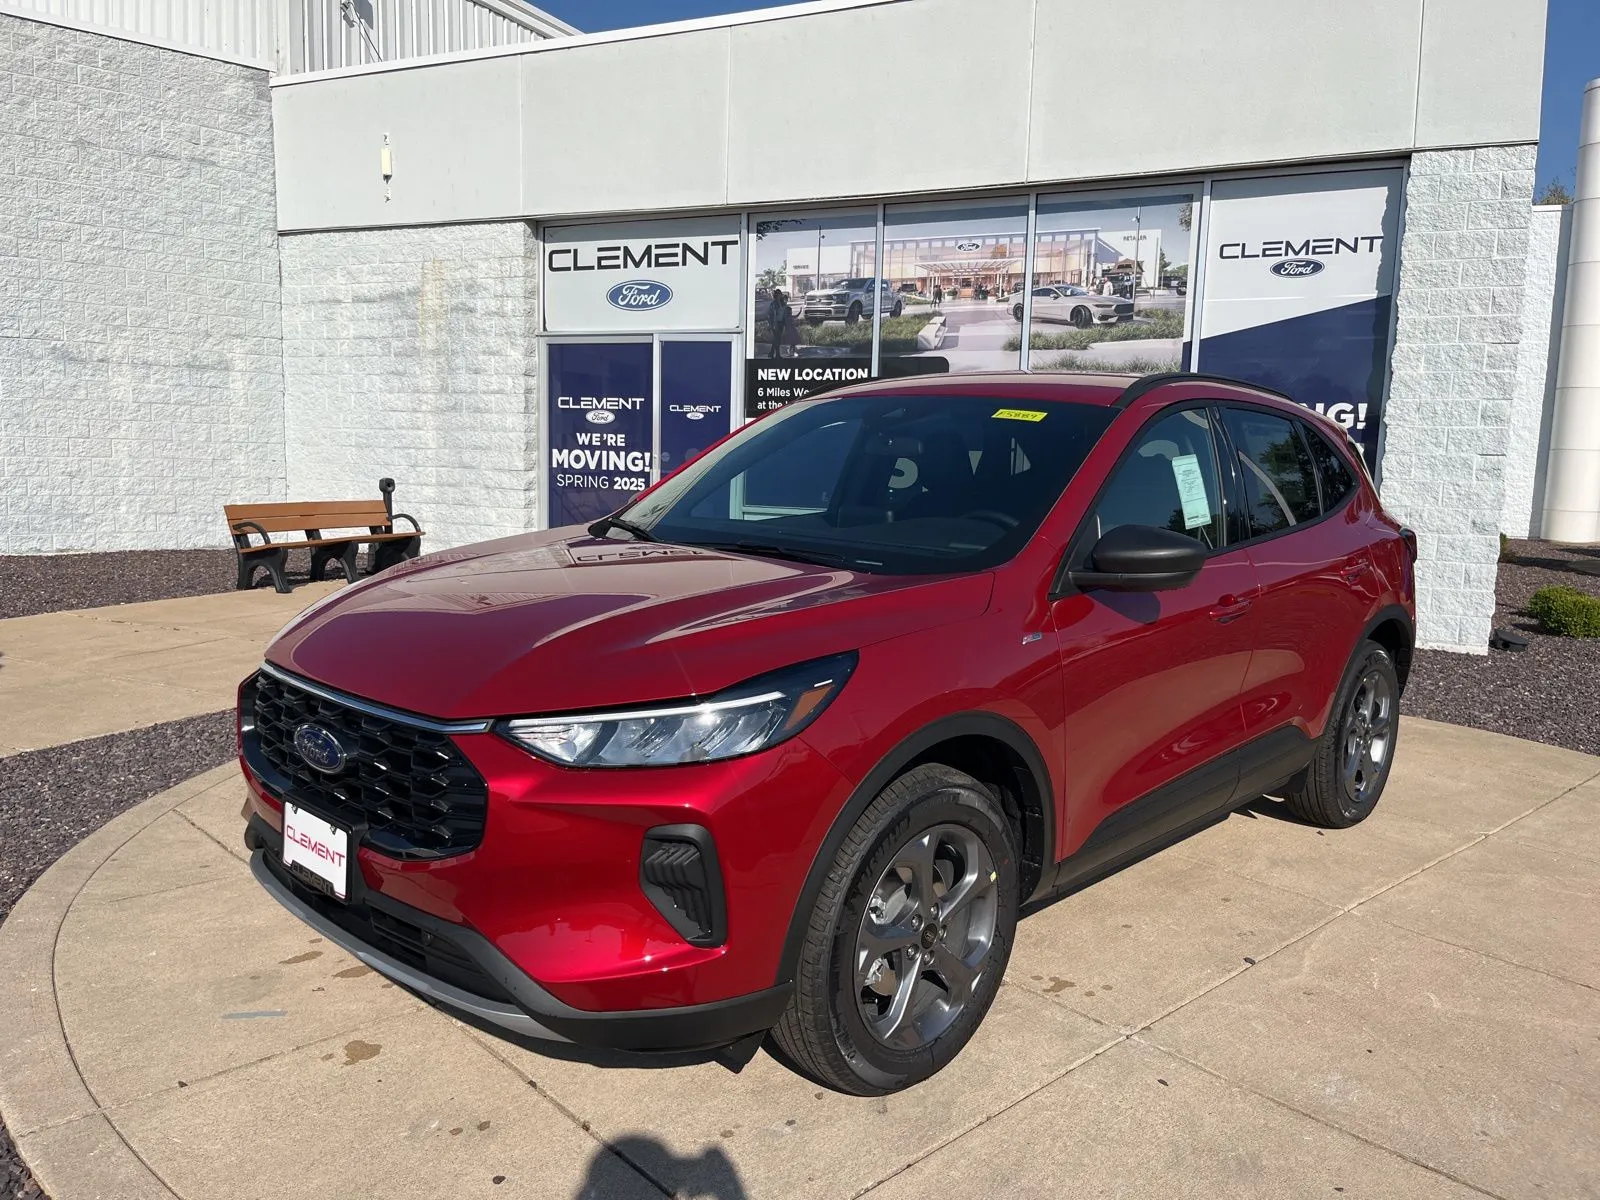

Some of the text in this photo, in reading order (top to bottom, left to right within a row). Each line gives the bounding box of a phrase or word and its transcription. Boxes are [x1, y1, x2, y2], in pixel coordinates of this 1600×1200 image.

[1219, 236, 1385, 260] CLEMENT
[548, 240, 739, 272] CLEMENT
[1279, 260, 1314, 275] Ford
[617, 284, 661, 306] Ford
[757, 367, 869, 381] NEW LOCATION
[757, 388, 764, 397] 6
[766, 387, 791, 397] Miles
[557, 396, 645, 410] CLEMENT
[669, 404, 722, 413] CLEMENT
[757, 401, 767, 410] at
[576, 432, 626, 447] WE'RE
[552, 448, 651, 473] MOVING!
[556, 474, 646, 491] SPRING 2025
[286, 824, 346, 868] CLEMENT
